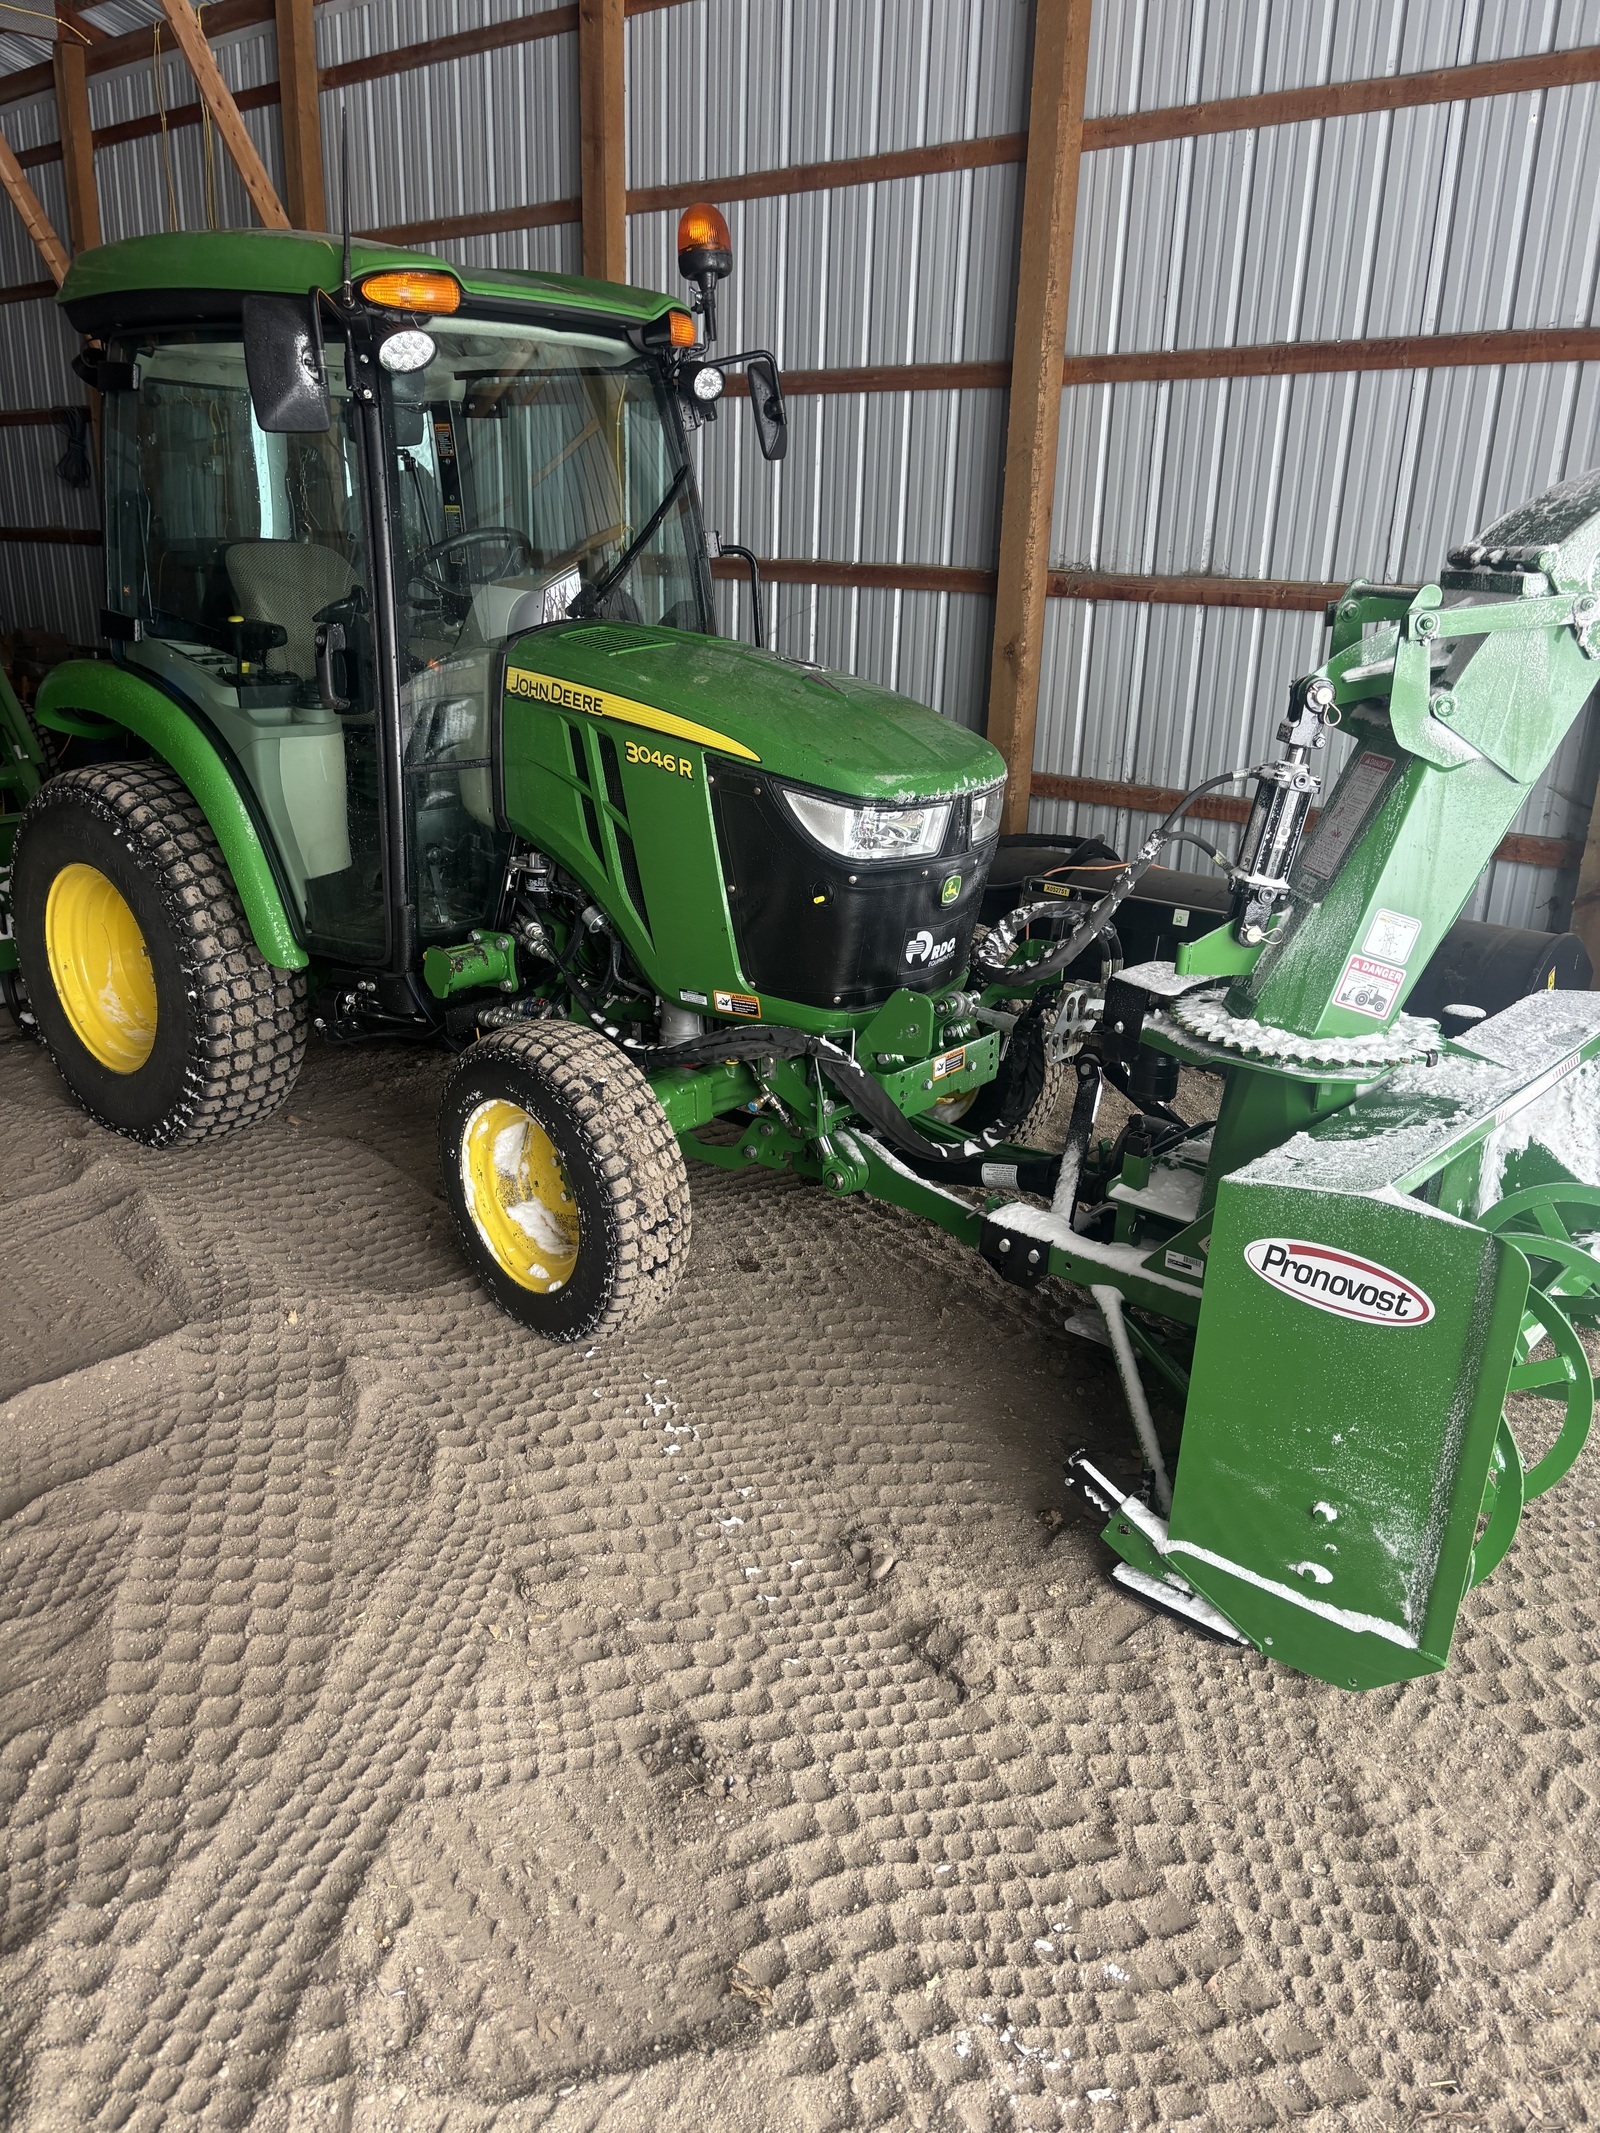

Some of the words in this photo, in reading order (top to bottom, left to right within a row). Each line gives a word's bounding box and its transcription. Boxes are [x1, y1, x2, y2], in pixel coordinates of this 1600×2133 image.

[511, 674, 549, 700] JOHN
[551, 682, 603, 714] DEERE
[1361, 961, 1403, 983] DANGER
[1261, 1244, 1411, 1317] Pronovost
